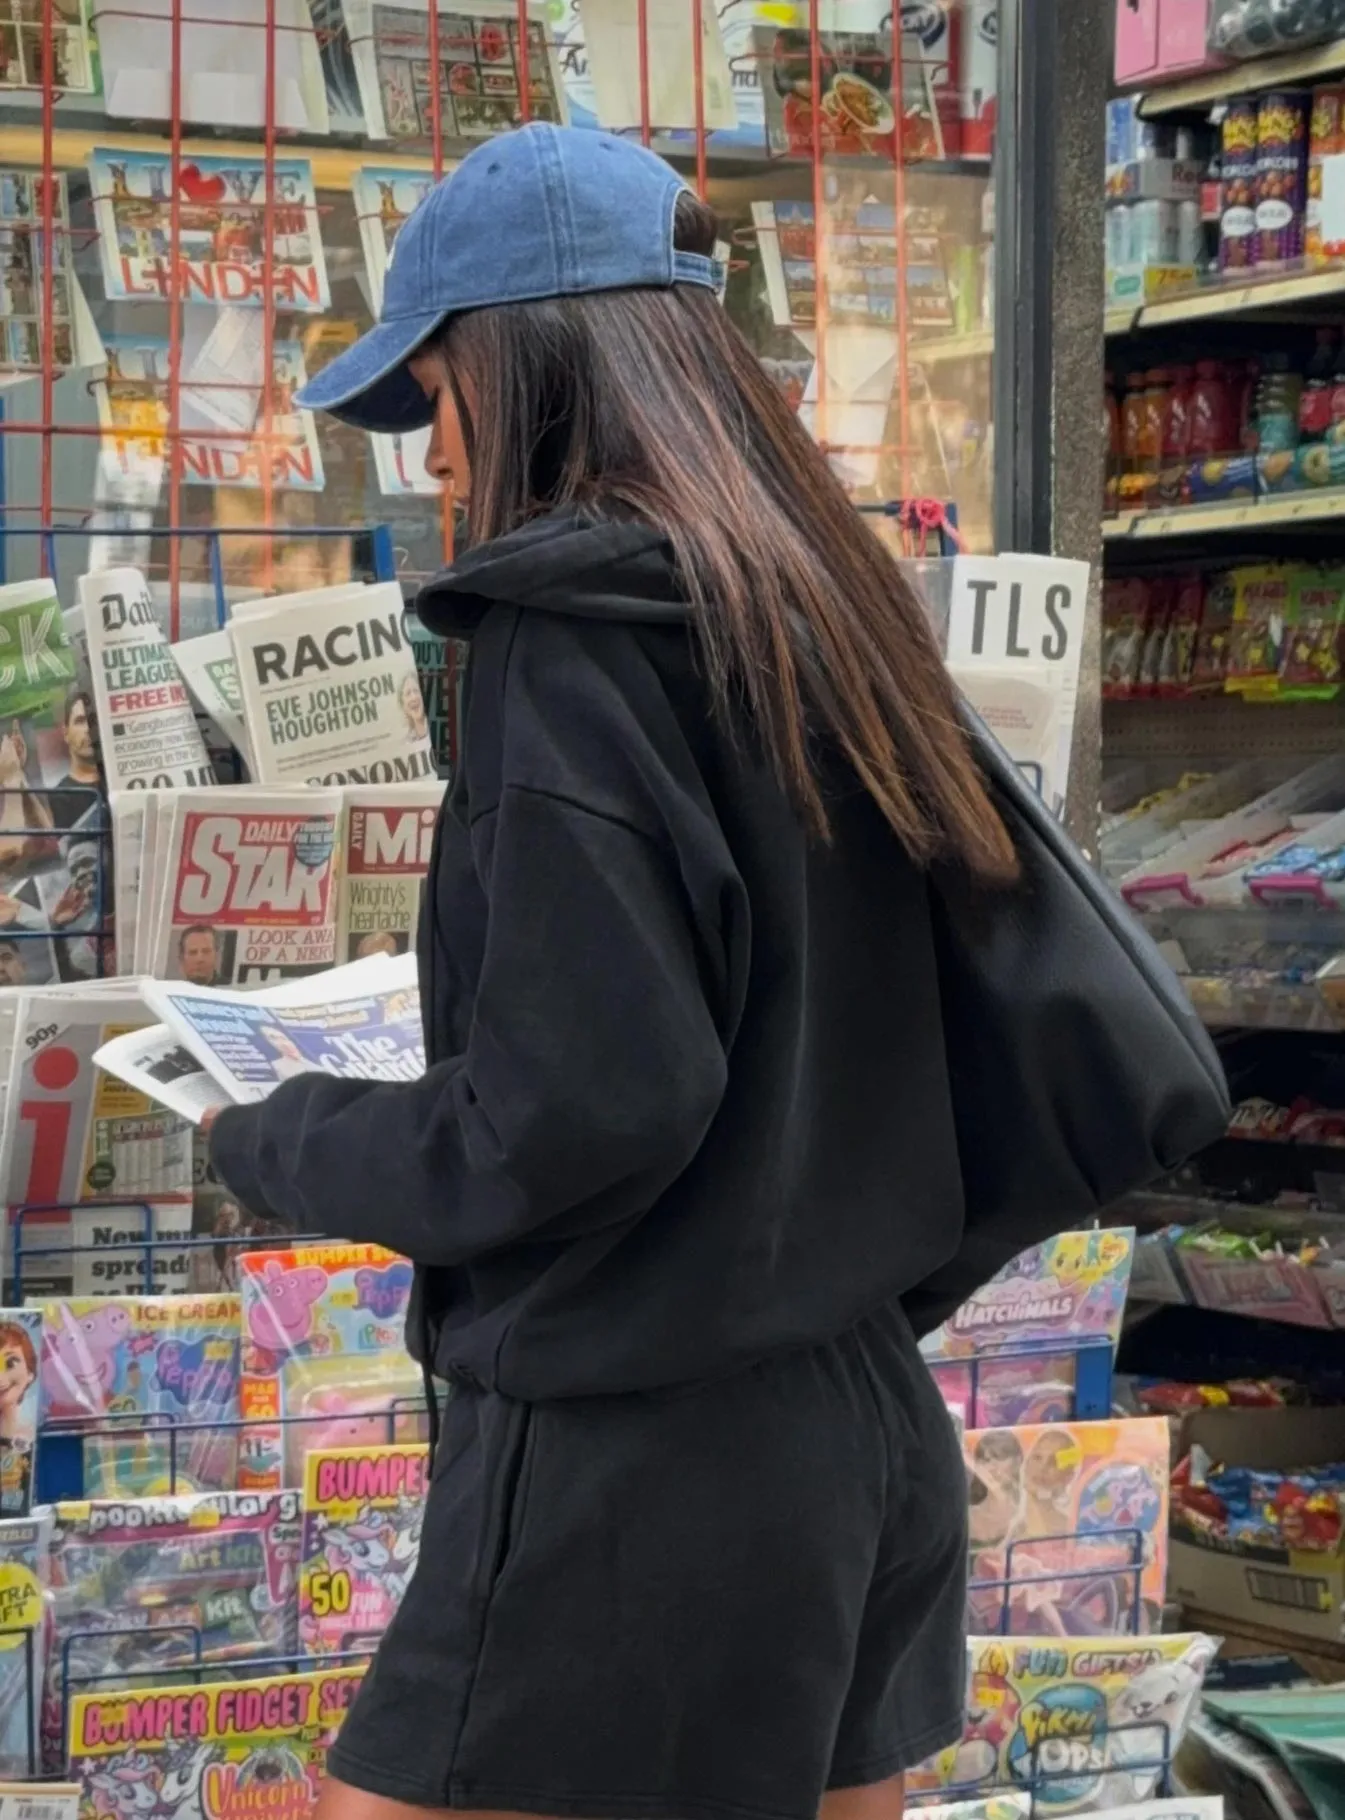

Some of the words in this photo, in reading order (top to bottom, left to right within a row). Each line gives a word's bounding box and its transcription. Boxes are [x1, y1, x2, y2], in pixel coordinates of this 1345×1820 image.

[967, 580, 1072, 661] TLS
[109, 687, 169, 713] FREE
[266, 695, 301, 724] EVE
[307, 672, 396, 716] JOHNSON
[270, 700, 380, 746] HOUGHTON
[245, 820, 298, 843] DAILY
[352, 812, 365, 850] DAILY
[179, 817, 330, 916] STAR
[349, 907, 411, 930] heartache
[249, 928, 297, 945] LOOK
[246, 946, 267, 962] OF
[276, 946, 292, 962] A
[25, 1022, 60, 1051] 90p
[322, 1031, 398, 1063] The
[91, 1226, 144, 1246] New
[136, 1304, 169, 1321] ICE
[955, 1297, 1074, 1331] HATCHIMALS
[206, 1595, 243, 1621] Kit
[309, 1570, 352, 1618] 50
[1013, 1646, 1068, 1680] FUN
[83, 1692, 209, 1747] BUMPER
[214, 1681, 313, 1735] FIDGET
[203, 1762, 309, 1818] Unicorn
